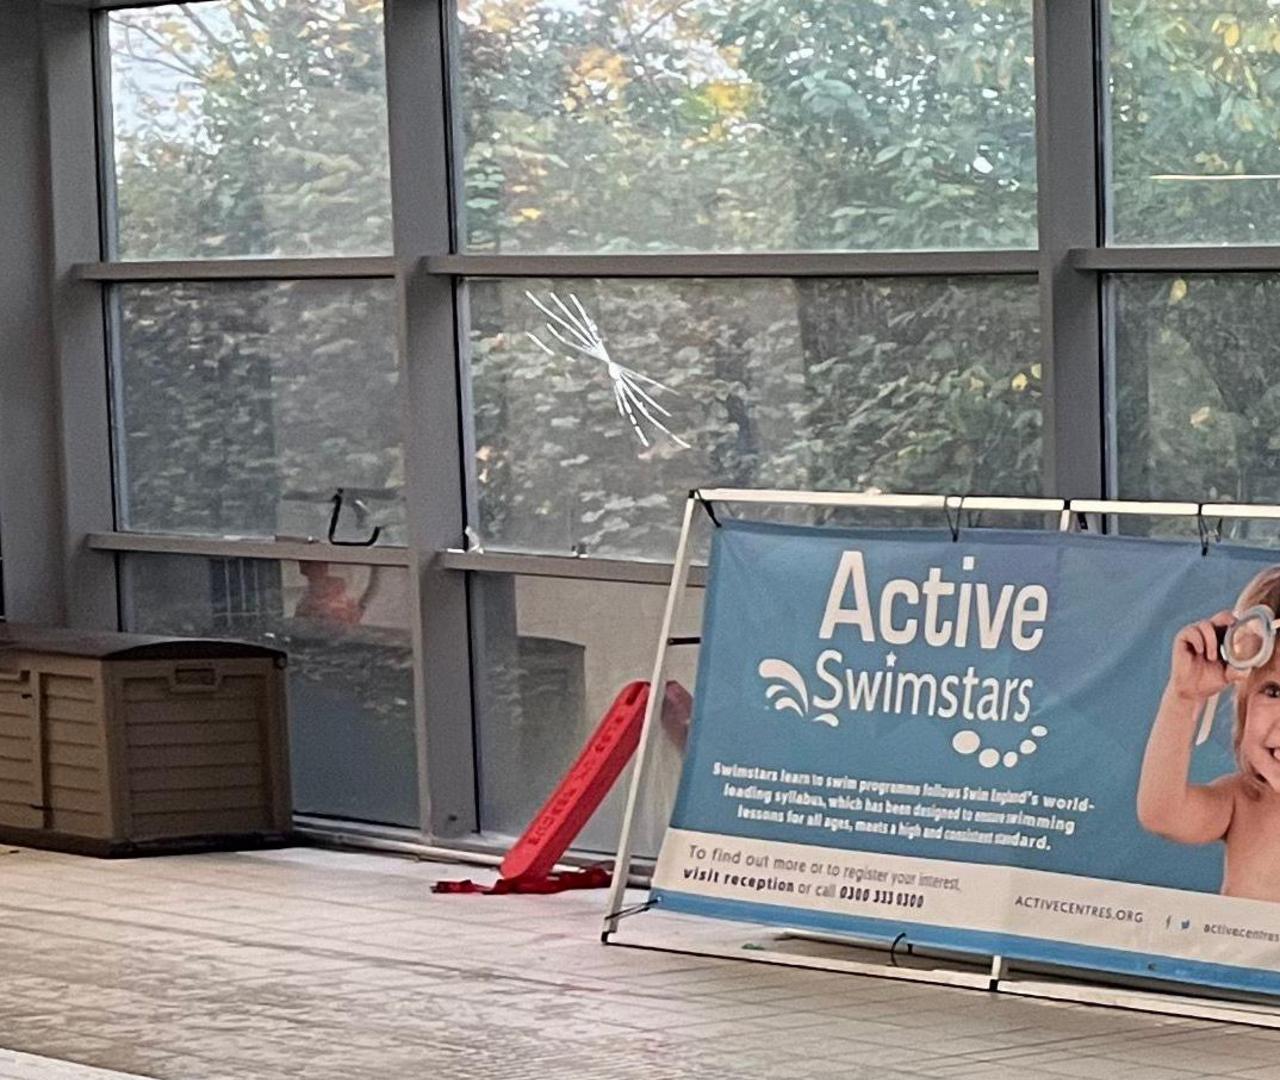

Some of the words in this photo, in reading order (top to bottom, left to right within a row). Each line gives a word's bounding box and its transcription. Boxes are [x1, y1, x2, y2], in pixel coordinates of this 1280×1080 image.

[818, 550, 1048, 651] Active
[813, 649, 1034, 723] Swimstars
[712, 761, 778, 782] Swimstars
[780, 769, 810, 785] learn
[812, 773, 824, 787] to
[826, 776, 857, 790] swim
[859, 780, 920, 796] programme
[1043, 795, 1095, 812] world-
[723, 782, 772, 804] leading
[774, 790, 827, 809] syllabus,
[828, 796, 863, 811] which
[864, 797, 884, 813] has
[885, 799, 911, 815] been
[913, 803, 961, 822] designed
[962, 807, 973, 822] to
[737, 804, 784, 823] lessons
[786, 810, 804, 824] for
[807, 813, 823, 827] all
[824, 815, 853, 832] ages,
[855, 820, 888, 834] meets
[890, 823, 896, 835] a
[898, 821, 921, 839] high
[923, 825, 944, 839] and
[689, 844, 706, 860] To
[711, 848, 742, 865] find
[745, 854, 770, 868] out
[773, 858, 807, 873] more
[810, 863, 823, 875] or
[827, 863, 840, 877] to
[843, 865, 889, 883] register
[890, 871, 916, 886] your
[683, 866, 719, 883] visit
[723, 873, 794, 892] reception
[798, 883, 812, 894] or
[815, 883, 836, 898] call
[840, 886, 870, 902] 0300
[872, 889, 894, 905] 333
[896, 893, 924, 908] 0300
[1015, 896, 1143, 924] ACTIVECENTRES.ORG
[1203, 923, 1280, 943] activecentres
